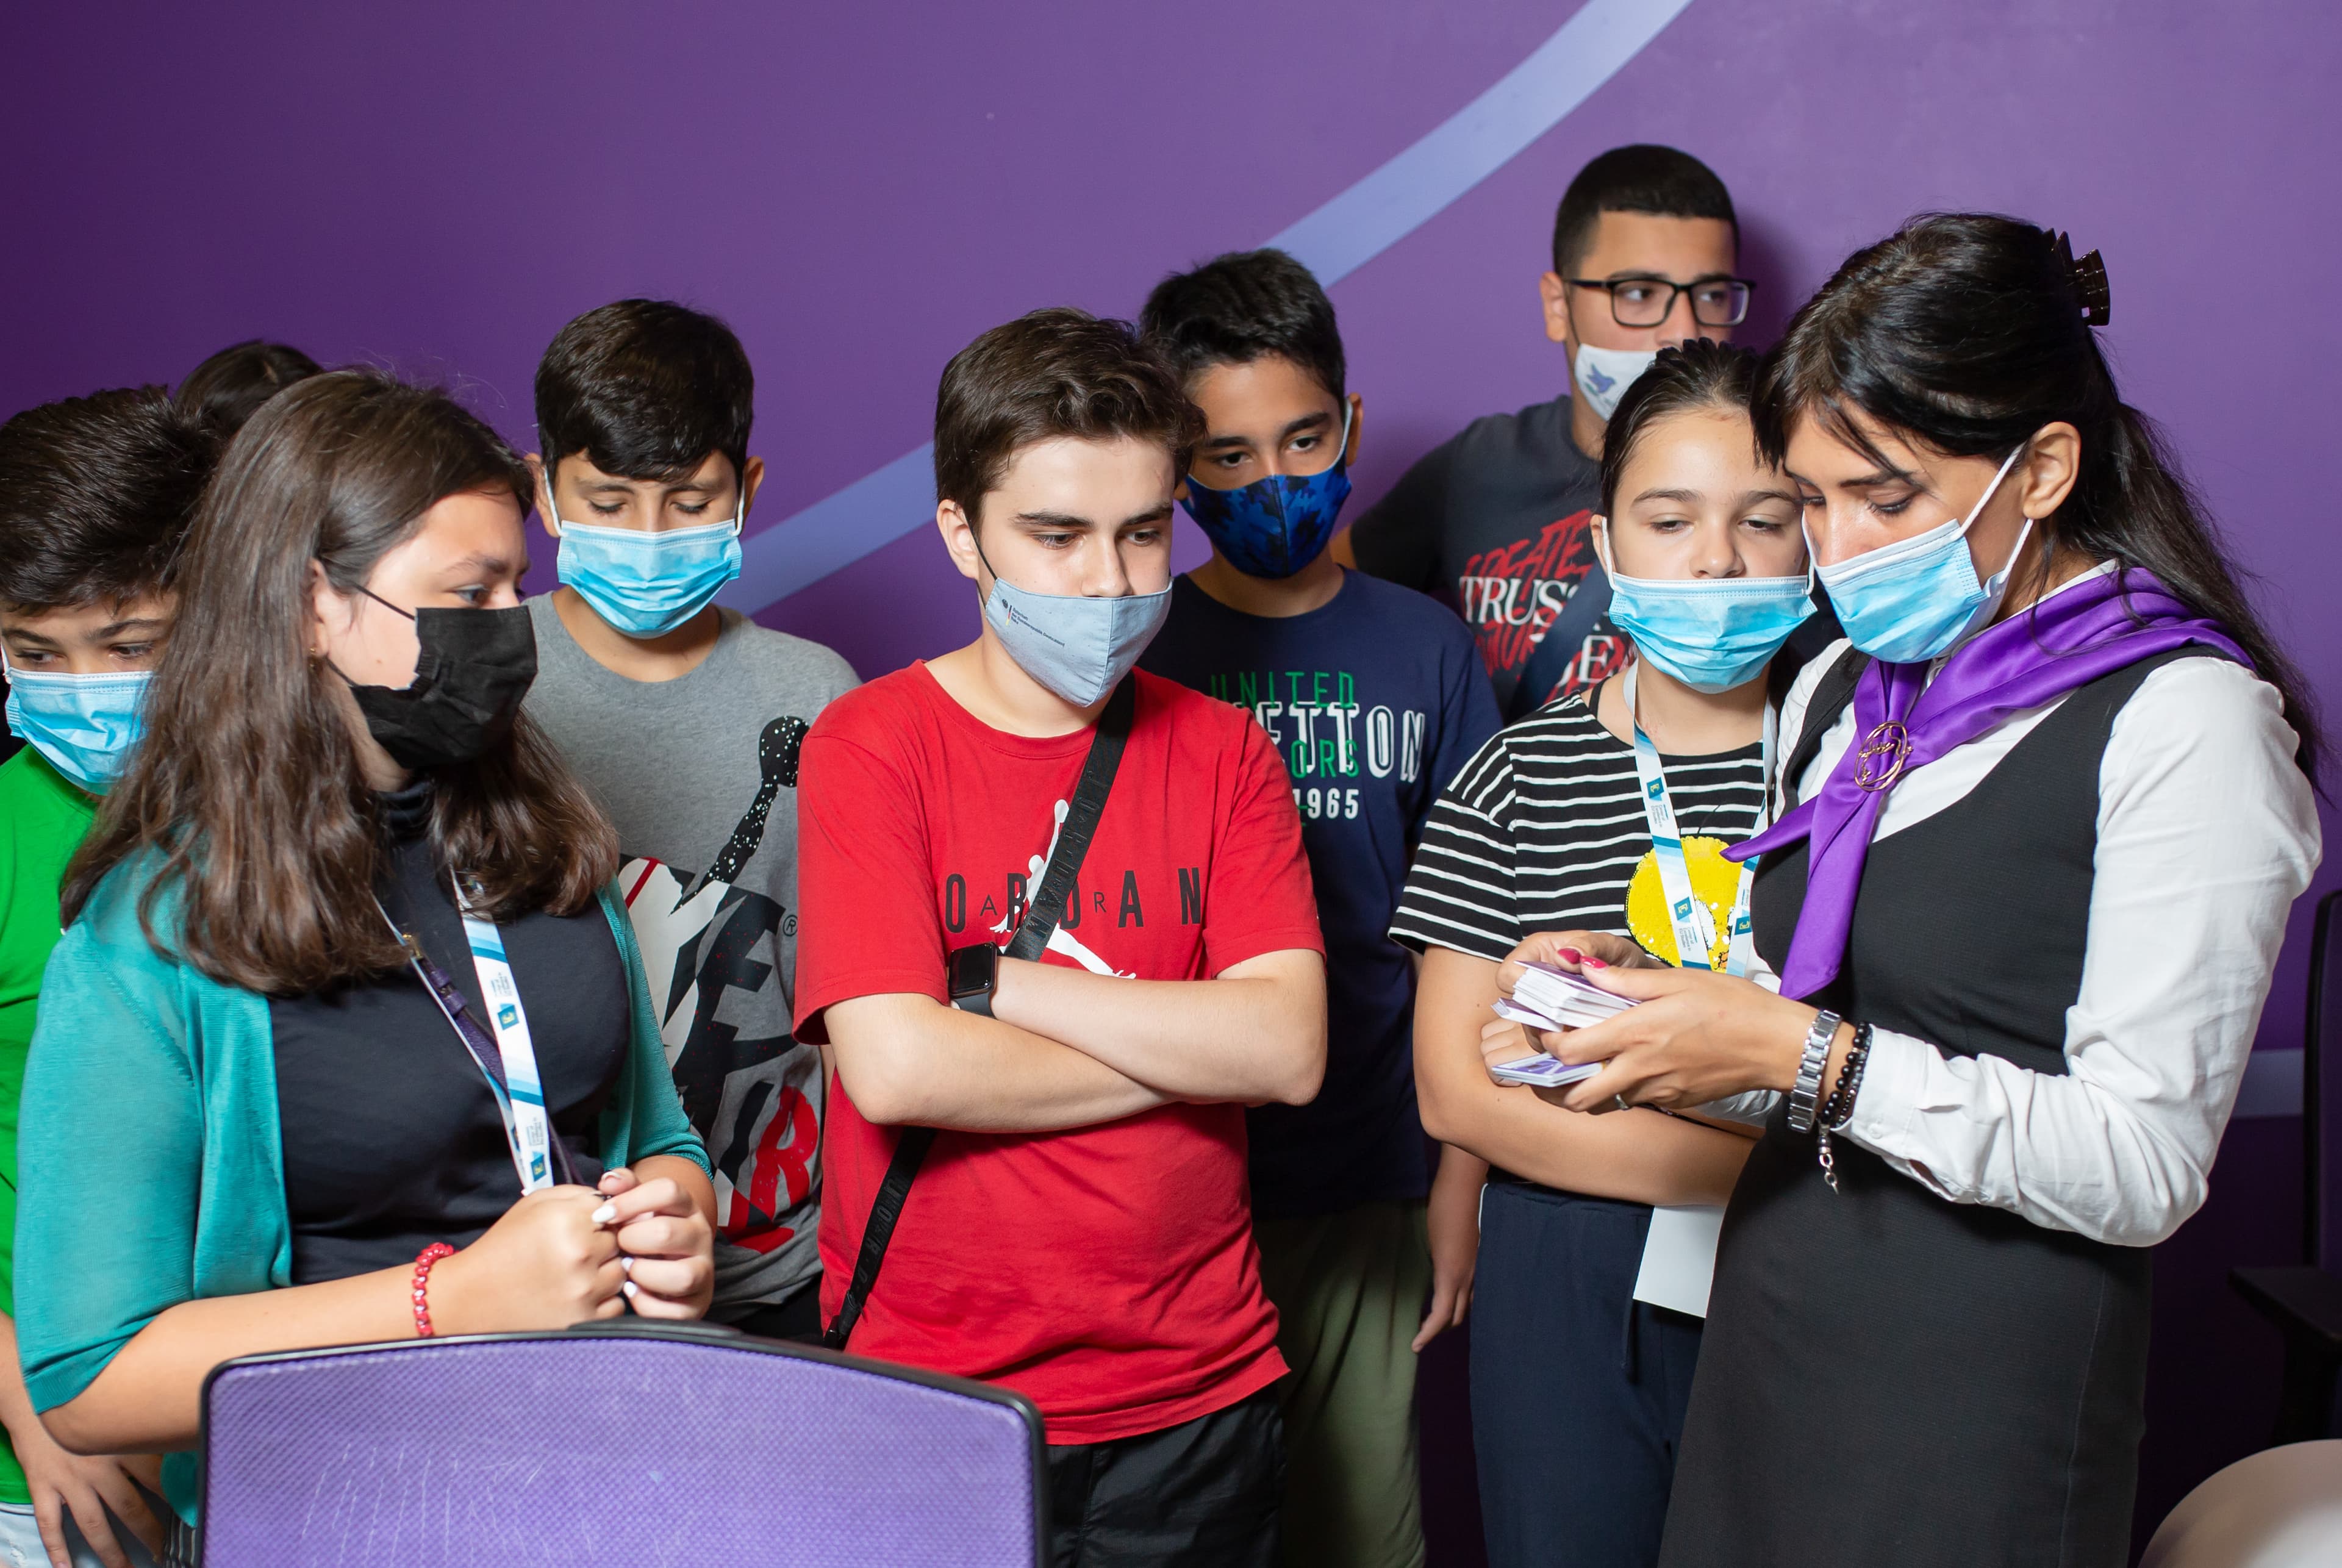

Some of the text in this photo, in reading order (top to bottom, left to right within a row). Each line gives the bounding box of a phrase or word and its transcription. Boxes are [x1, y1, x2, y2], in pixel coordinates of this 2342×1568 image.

[1459, 576, 1580, 628] TRUS
[1211, 671, 1355, 711] UNITED
[1233, 701, 1425, 782] ETTON
[1291, 739, 1359, 778] ORS
[945, 867, 1202, 934] ORDAN
